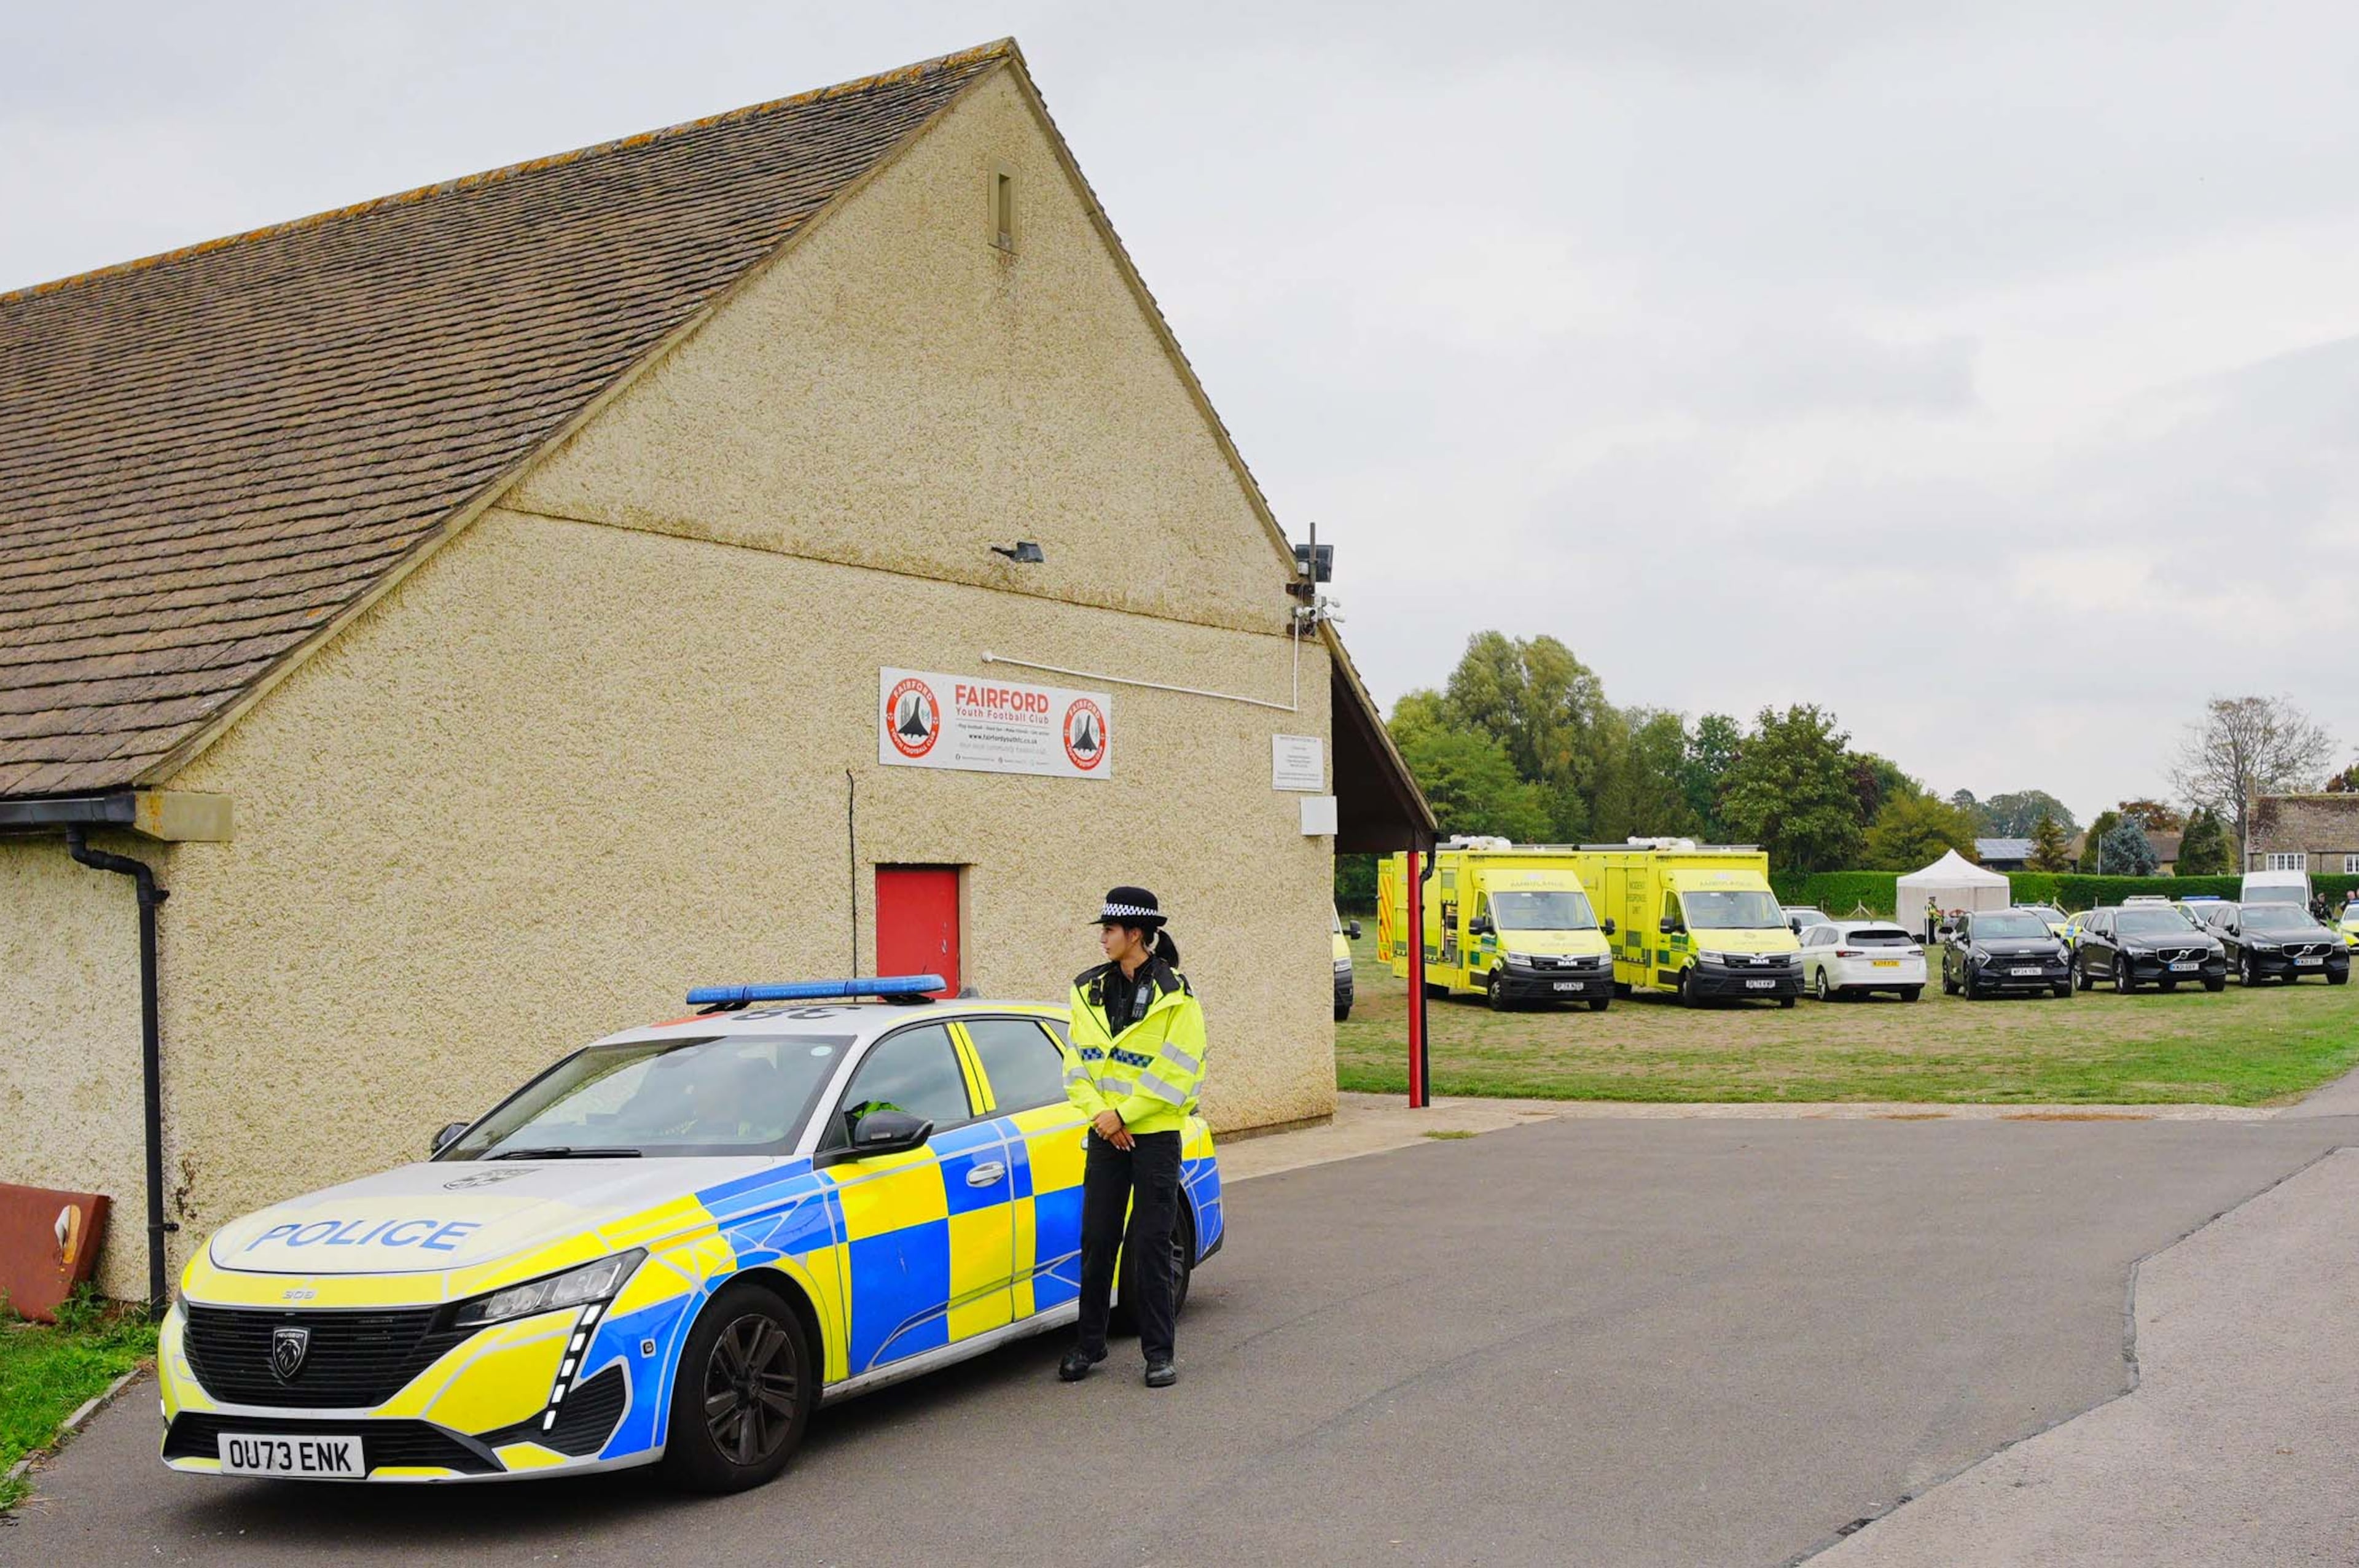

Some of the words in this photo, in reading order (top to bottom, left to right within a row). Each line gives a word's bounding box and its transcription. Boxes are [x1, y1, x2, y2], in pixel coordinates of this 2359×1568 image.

[894, 680, 933, 701] FAIRFORD
[955, 684, 1049, 713] FAIRFORD
[956, 706, 983, 717] Youth
[987, 710, 1025, 722] Football
[1029, 714, 1049, 724] Club
[1069, 700, 1101, 719] FAIRFORD
[244, 1220, 482, 1252] POLICE
[282, 1290, 316, 1300] 308
[229, 1440, 292, 1470] OU73
[299, 1442, 352, 1472] ENK
